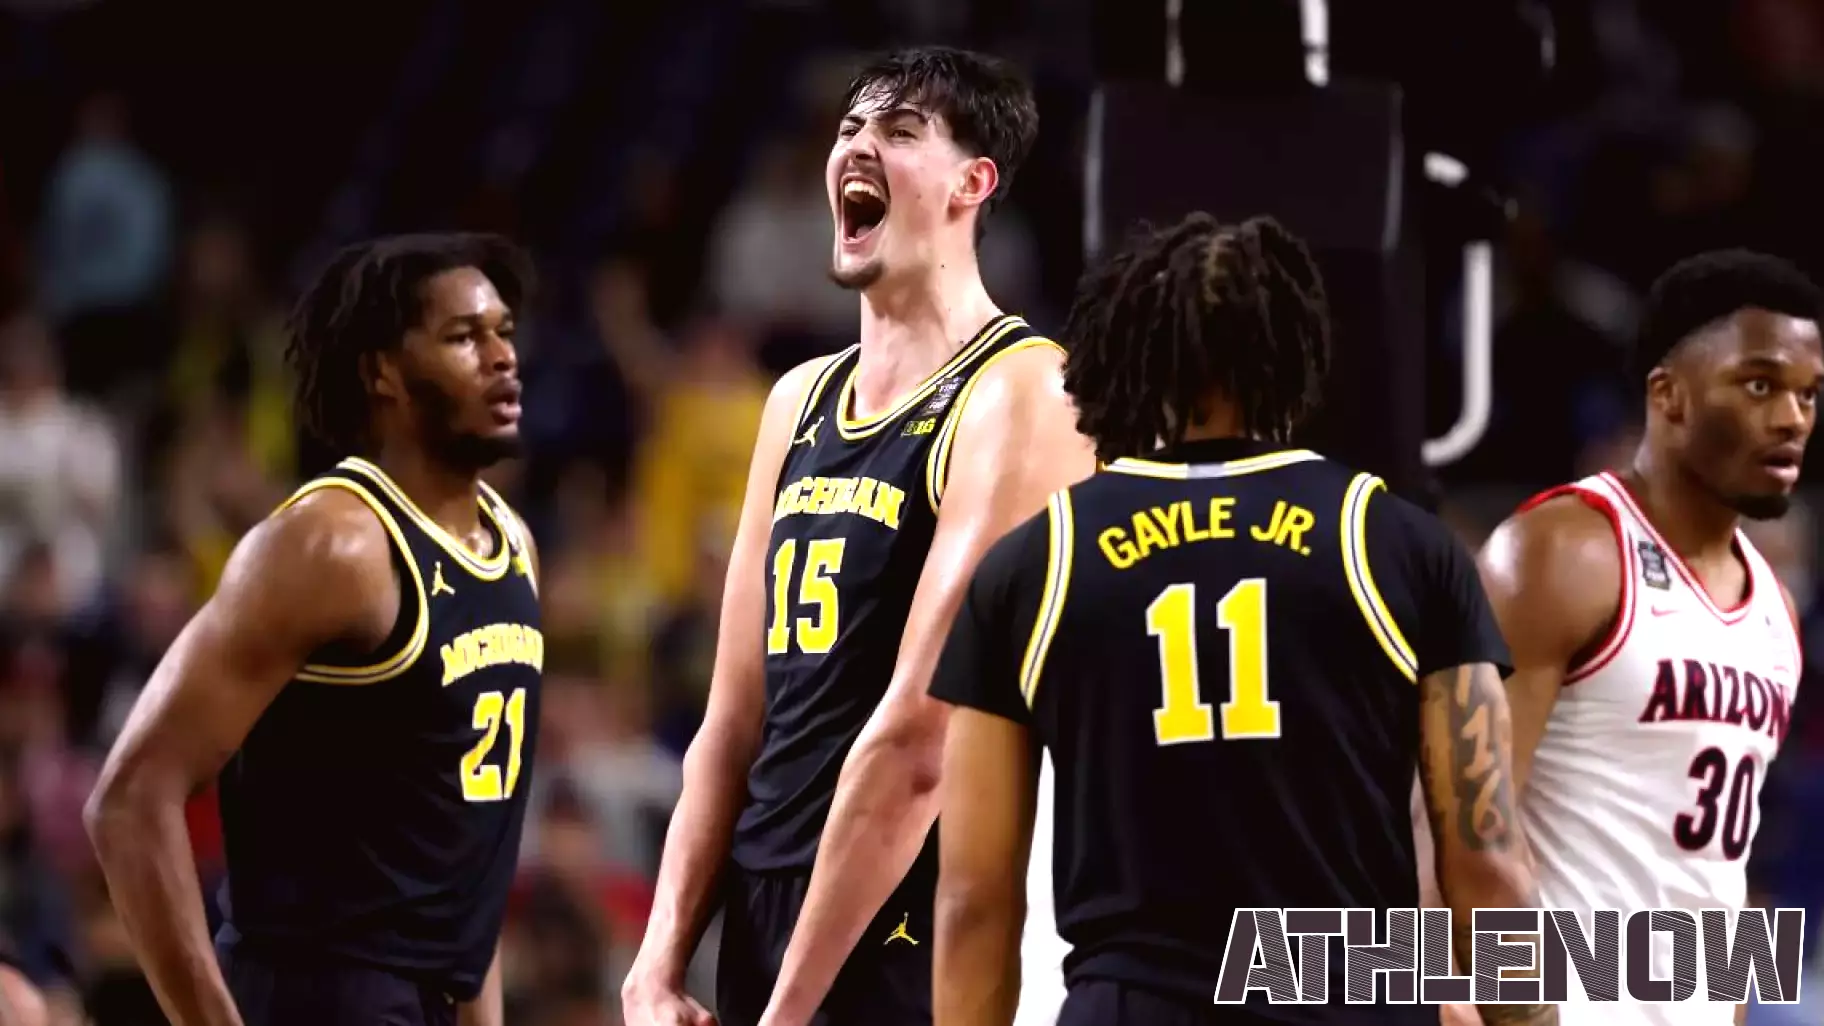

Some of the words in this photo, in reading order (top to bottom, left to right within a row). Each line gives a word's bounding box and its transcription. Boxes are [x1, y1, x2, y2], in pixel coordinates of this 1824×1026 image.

[1098, 497, 1236, 569] GAYLE
[1250, 500, 1315, 556] JR.
[767, 537, 846, 655] 15
[1145, 577, 1281, 746] 11
[1638, 658, 1793, 748] ARIZON
[460, 687, 527, 802] 21
[1673, 746, 1757, 861] 30
